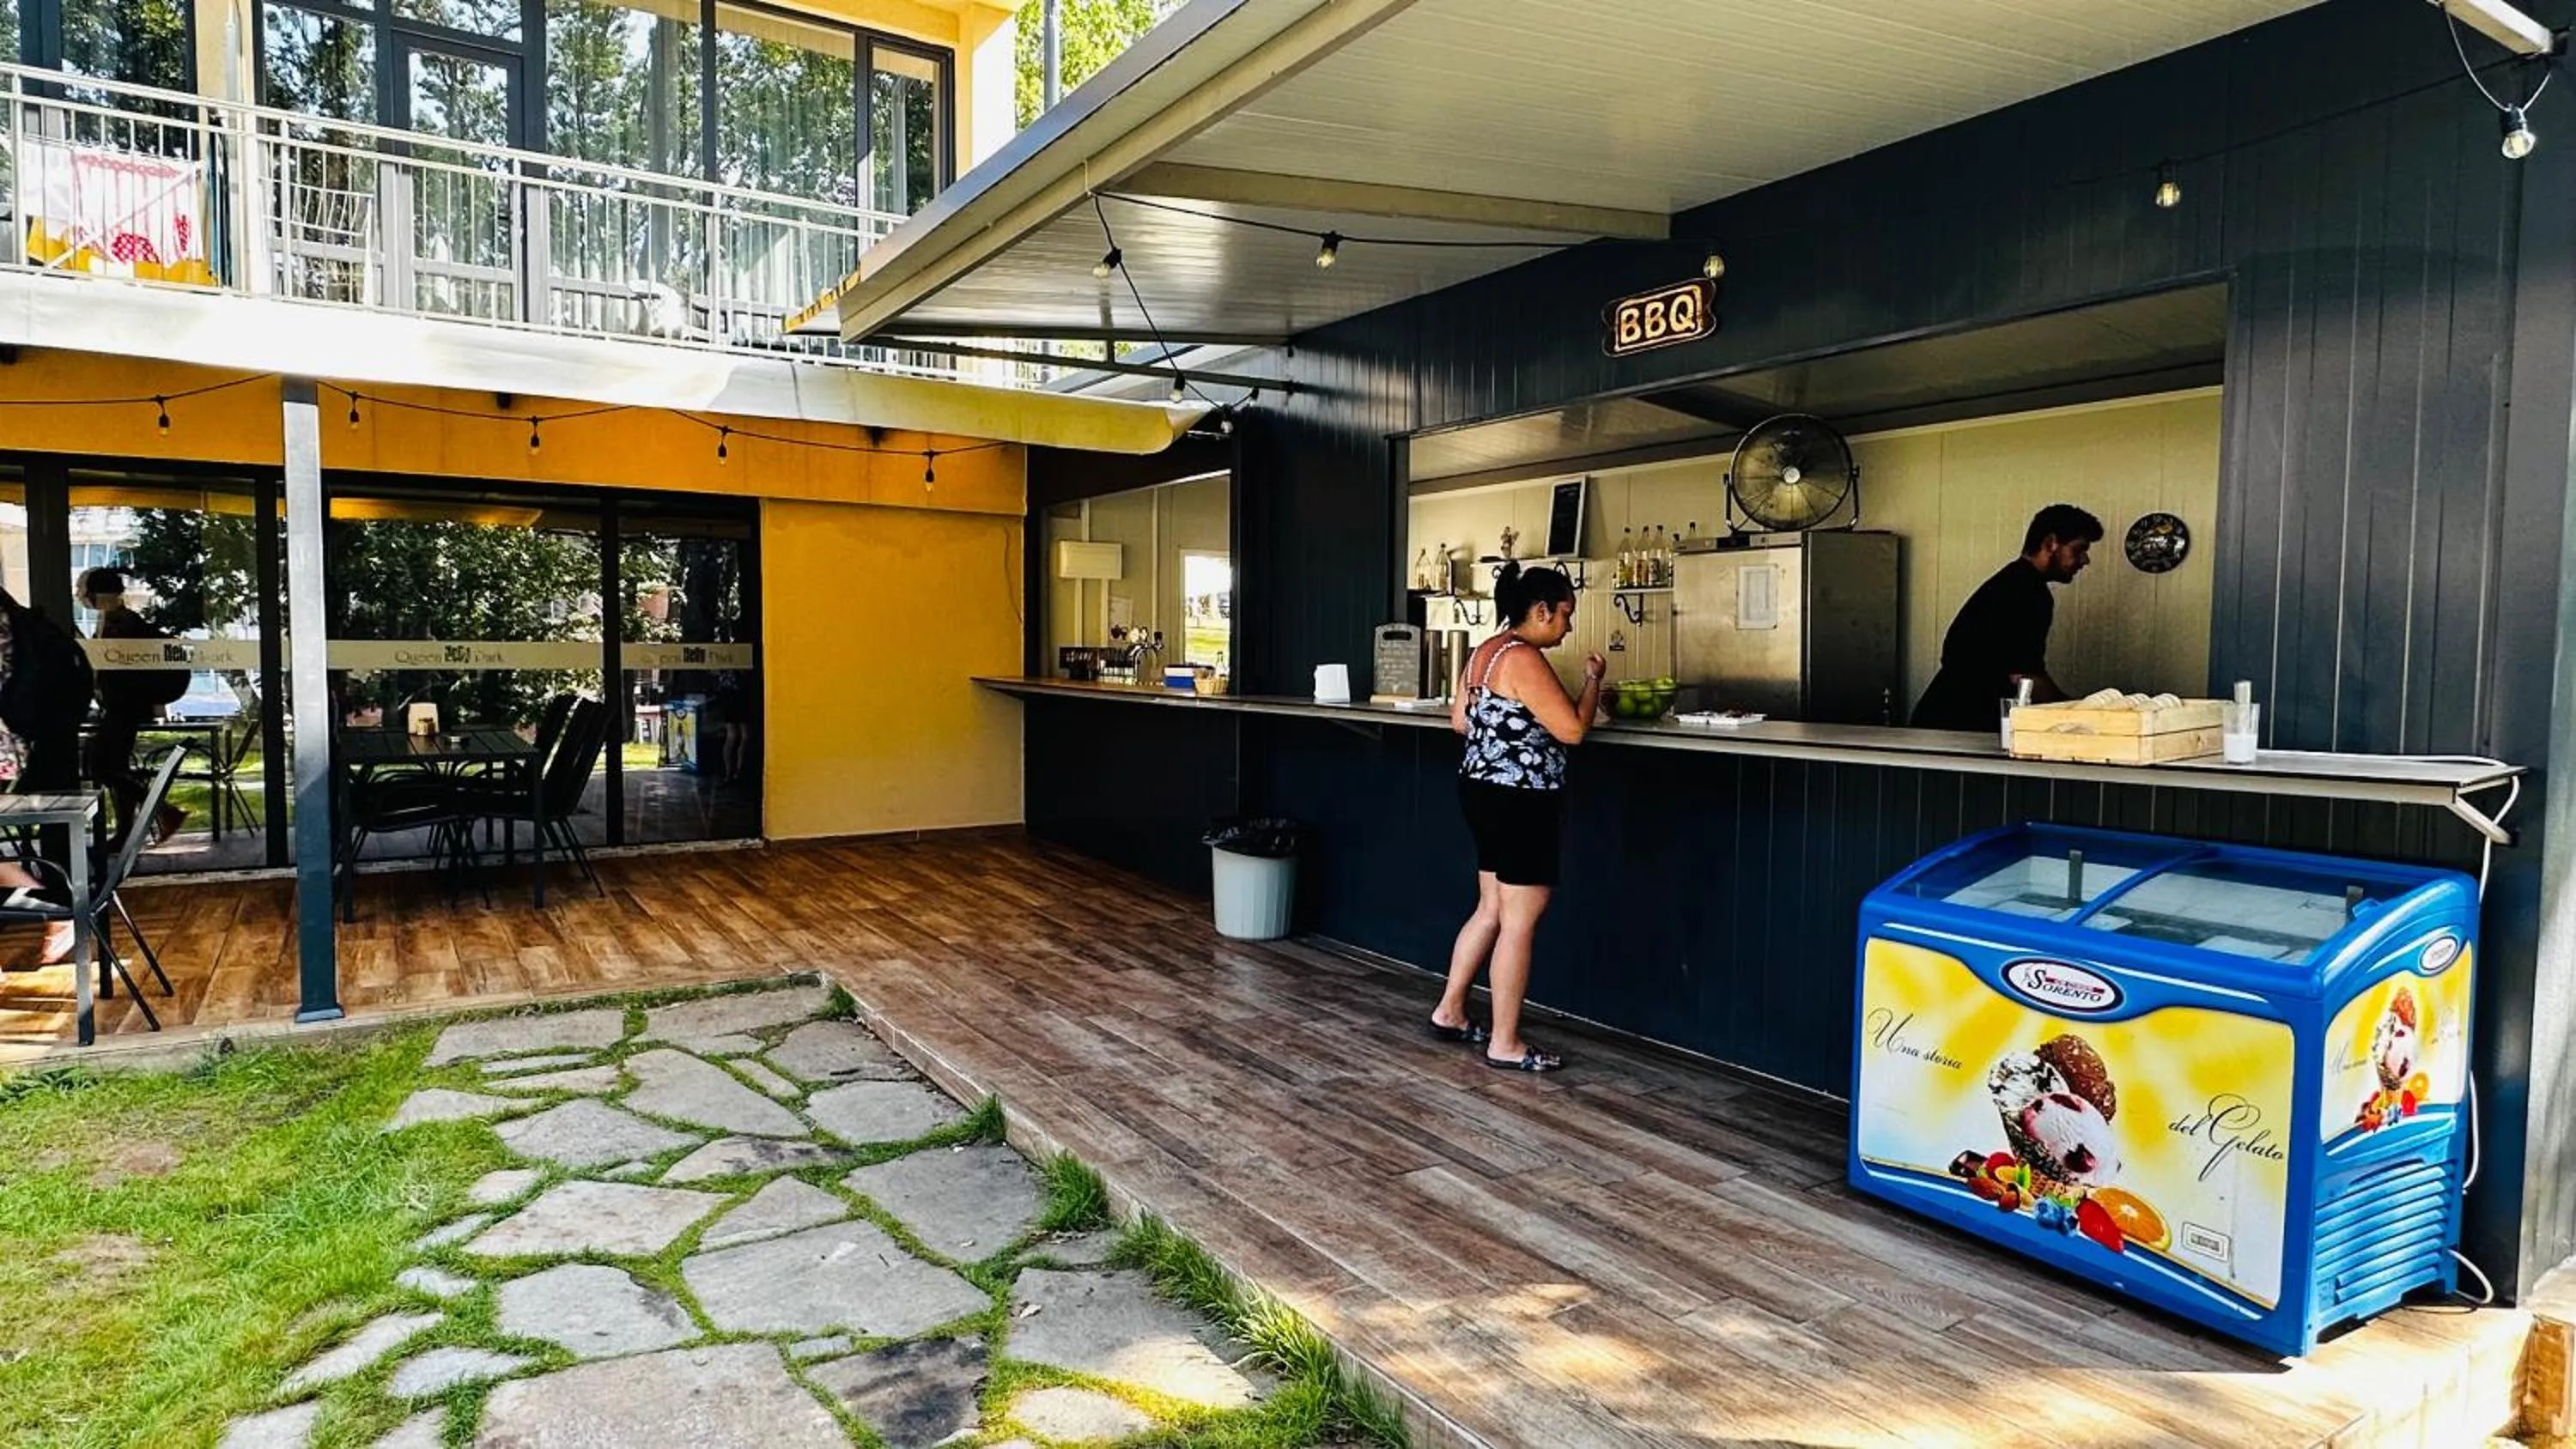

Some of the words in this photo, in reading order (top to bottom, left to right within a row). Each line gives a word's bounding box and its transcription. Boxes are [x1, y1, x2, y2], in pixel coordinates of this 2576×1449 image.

[1620, 294, 1696, 344] BBQ
[104, 647, 161, 665] Queen
[1866, 1007, 1919, 1057] Una
[1923, 1049, 1963, 1070] storia
[2168, 1113, 2211, 1136] del
[2197, 1092, 2284, 1182] Gelato
